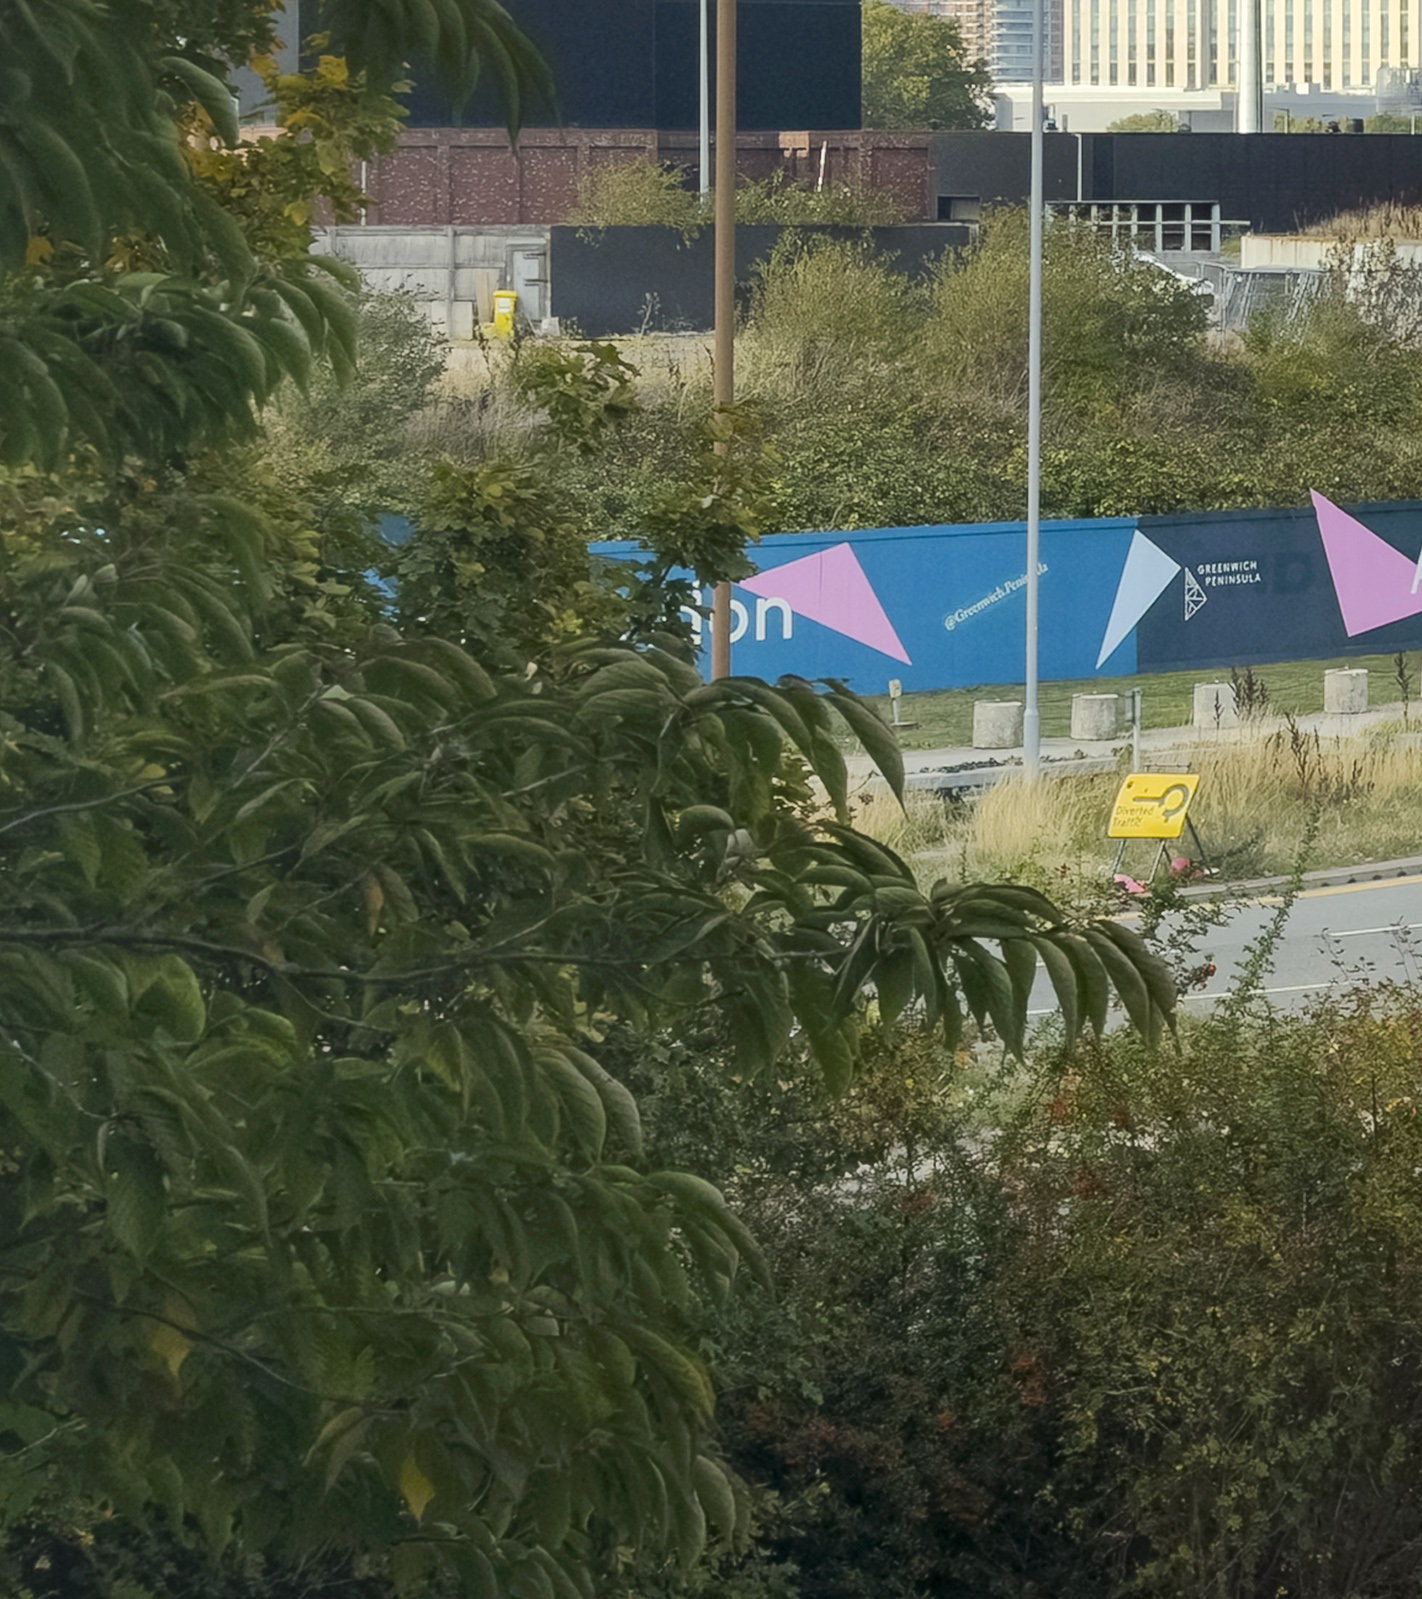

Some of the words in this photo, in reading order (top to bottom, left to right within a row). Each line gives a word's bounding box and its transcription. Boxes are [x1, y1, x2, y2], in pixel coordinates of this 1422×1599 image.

[1197, 560, 1258, 575] GREENWICH
[1205, 572, 1262, 587] PENINSULA
[1115, 806, 1155, 816] Diverted
[1113, 817, 1143, 827] Traffic
